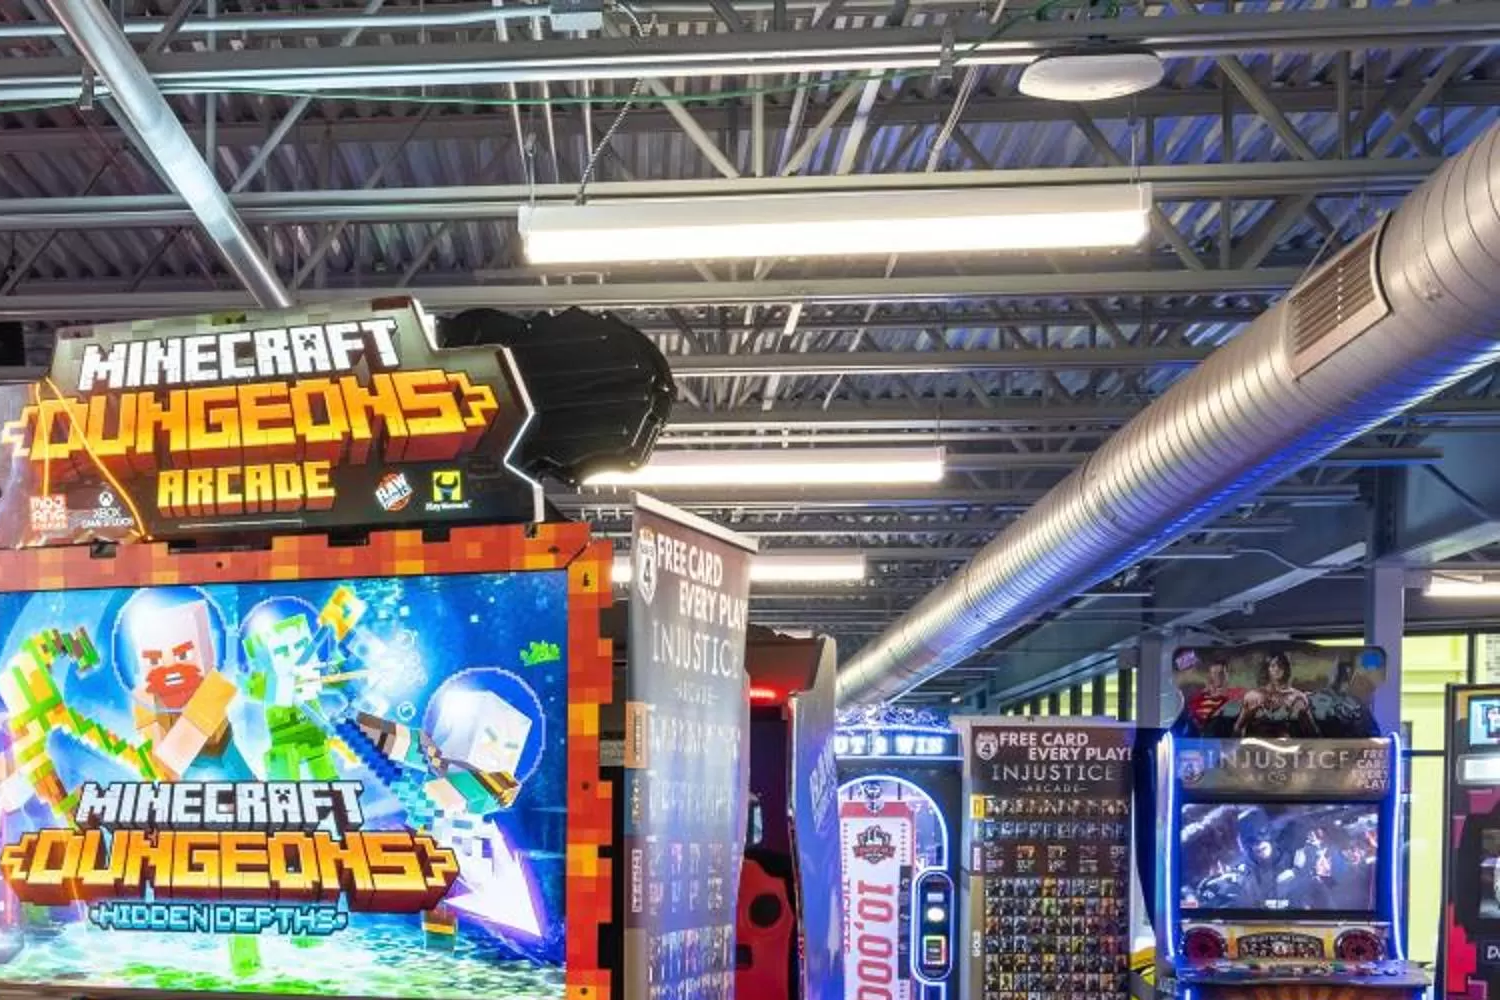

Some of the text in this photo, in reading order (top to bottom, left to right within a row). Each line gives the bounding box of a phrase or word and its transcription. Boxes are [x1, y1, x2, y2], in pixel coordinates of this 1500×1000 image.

[78, 318, 398, 391] MINECRAFT
[30, 369, 488, 465] DUNGEONS
[157, 461, 336, 516] ARCADE
[656, 534, 723, 586] FREE CARD
[679, 578, 717, 624] EVERY
[895, 734, 946, 755] WIN
[1000, 732, 1088, 747] FREE CARD
[1029, 747, 1132, 761] EVERY PLAY!
[991, 763, 1115, 781] INJUSTICE
[1025, 784, 1080, 793] ARCADE
[78, 780, 364, 829] MINECRAFT
[27, 828, 428, 895] DUNGEONS
[98, 902, 338, 935] HIDDEN DEPTHS
